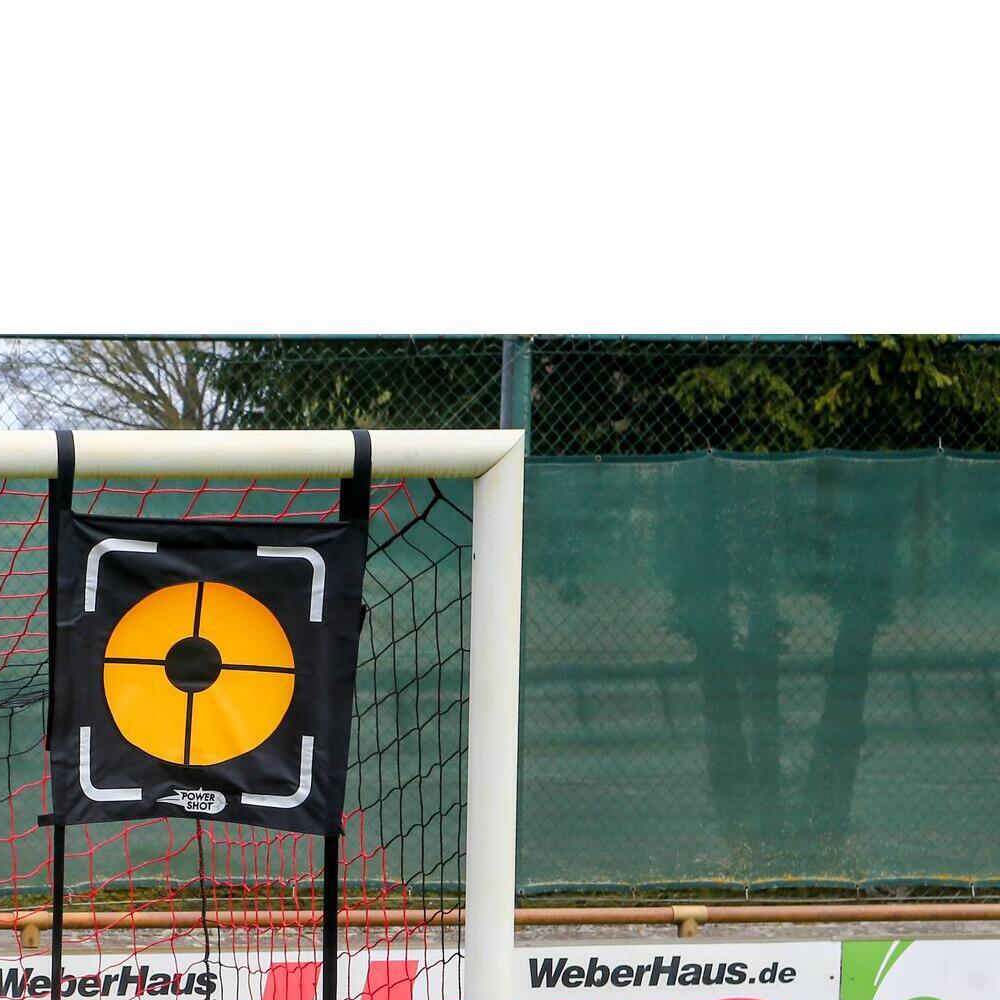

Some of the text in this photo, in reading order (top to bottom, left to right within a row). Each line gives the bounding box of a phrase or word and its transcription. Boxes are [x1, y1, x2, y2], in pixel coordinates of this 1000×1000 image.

[181, 792, 215, 802] POWER
[187, 801, 214, 810] SHOT
[528, 955, 797, 988] WeberHaus.de
